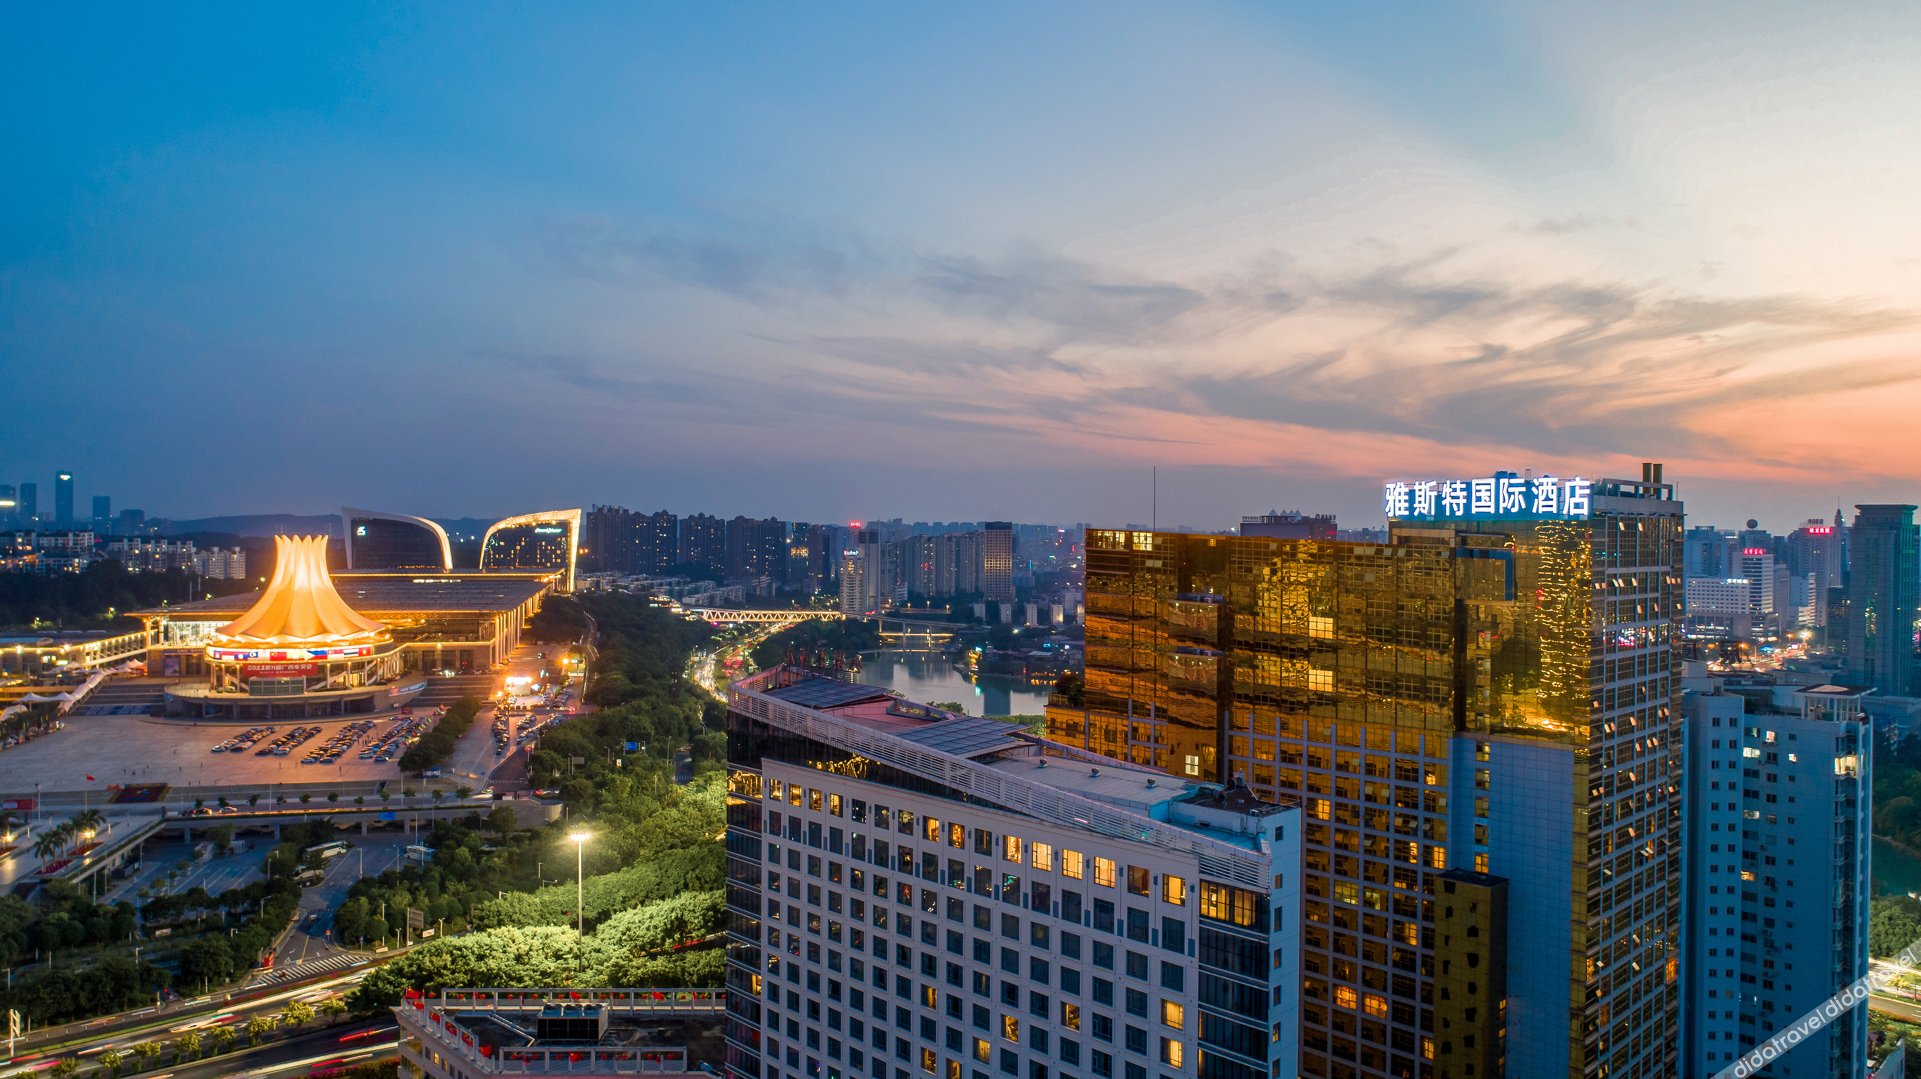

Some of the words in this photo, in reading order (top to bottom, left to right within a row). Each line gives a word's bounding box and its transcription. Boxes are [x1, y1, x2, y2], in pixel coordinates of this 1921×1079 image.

[1384, 476, 1591, 517] 雅斯特国际酒店
